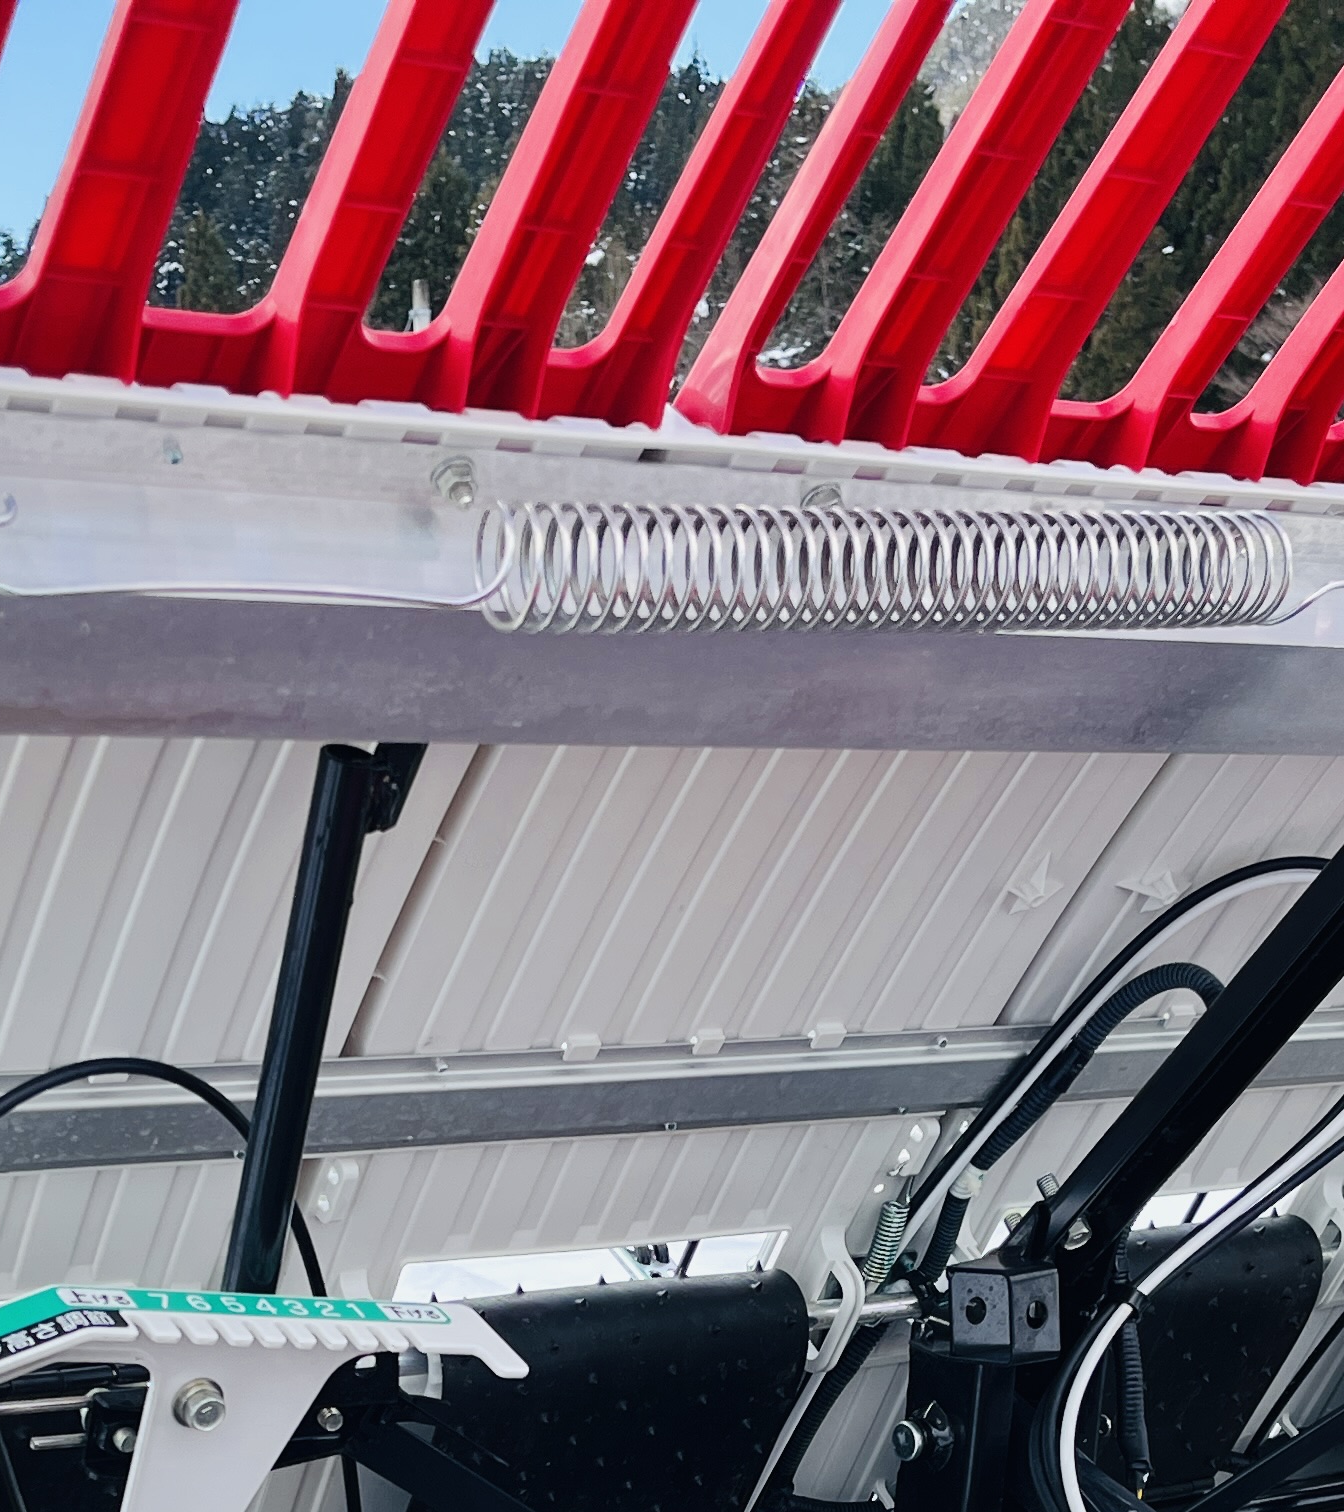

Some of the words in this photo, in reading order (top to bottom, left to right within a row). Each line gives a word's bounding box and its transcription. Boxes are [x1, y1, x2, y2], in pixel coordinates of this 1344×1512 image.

[147, 1292, 169, 1310] 7
[186, 1295, 212, 1312] 6
[219, 1296, 246, 1313] 5
[255, 1298, 278, 1315] 4
[285, 1299, 309, 1316] 3
[314, 1301, 341, 1318] 2
[345, 1302, 366, 1319] 1
